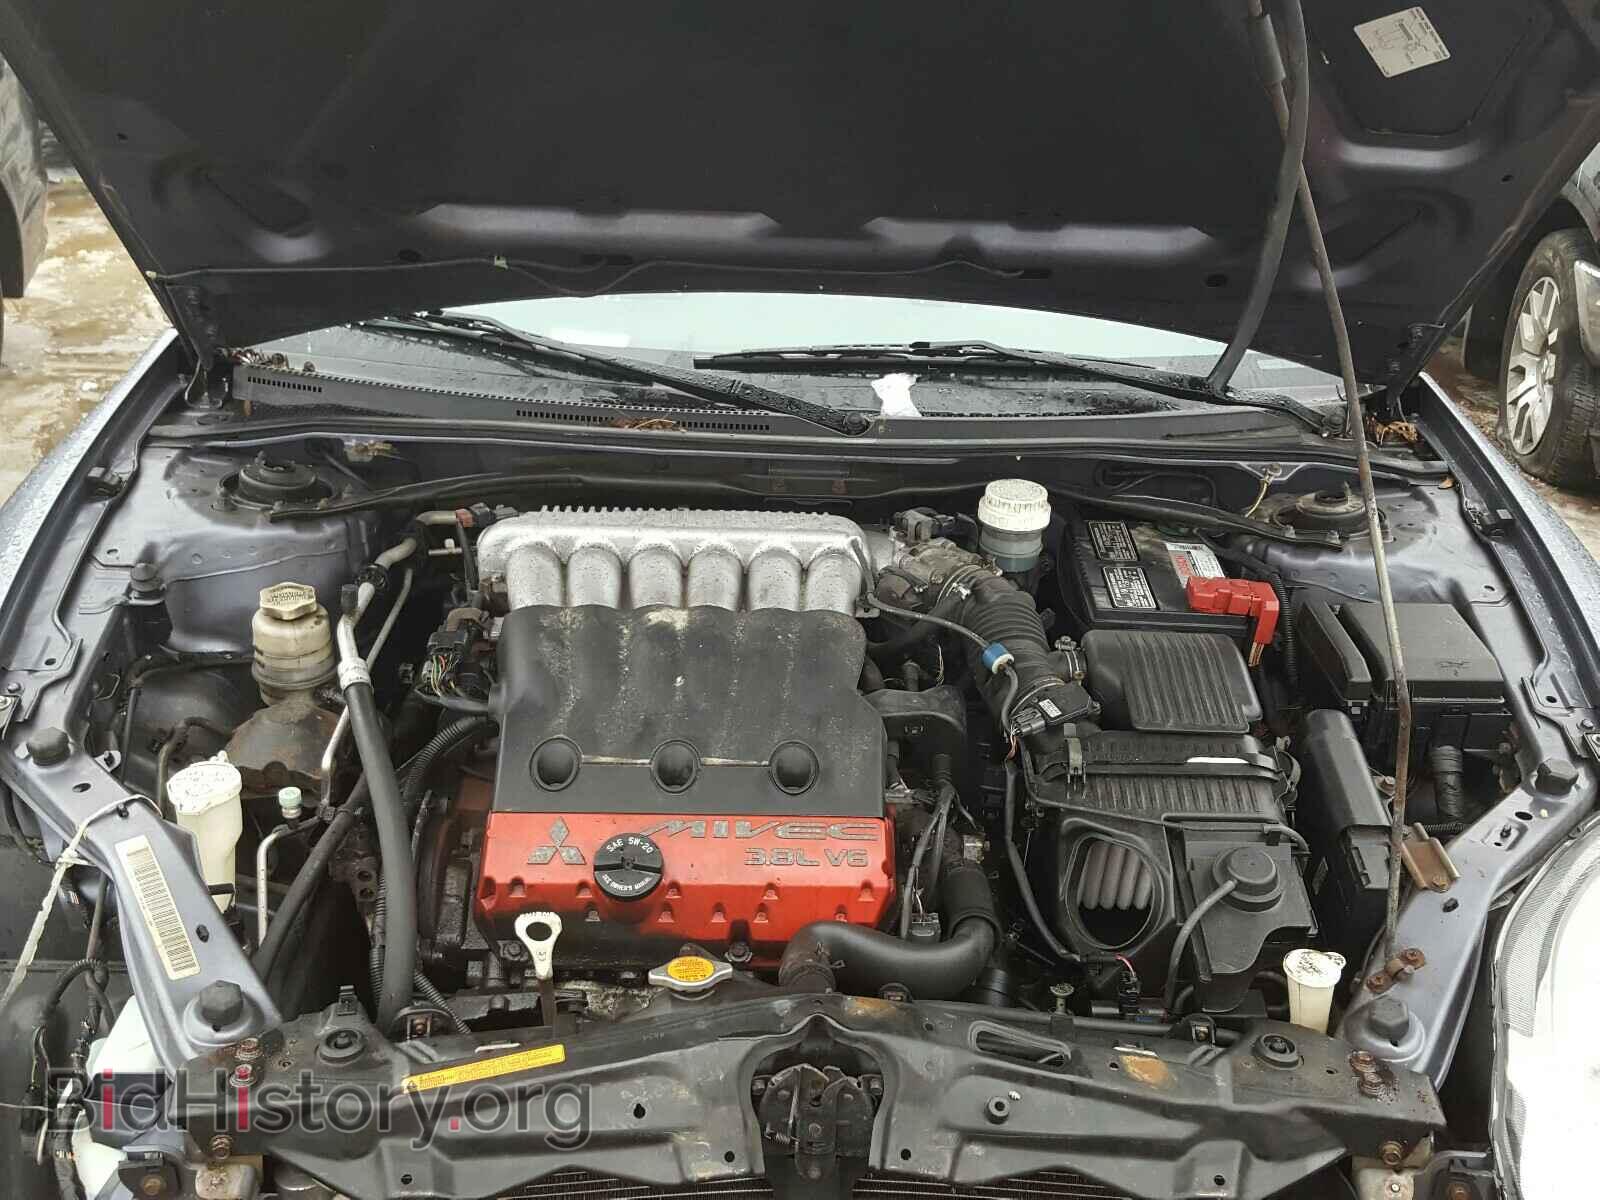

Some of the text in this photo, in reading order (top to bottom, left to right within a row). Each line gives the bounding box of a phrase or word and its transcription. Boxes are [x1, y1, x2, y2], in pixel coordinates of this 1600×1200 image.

[638, 818, 880, 841] MIVEC
[606, 836, 654, 853] SAE 5W-20
[744, 848, 869, 867] 3.8L V6
